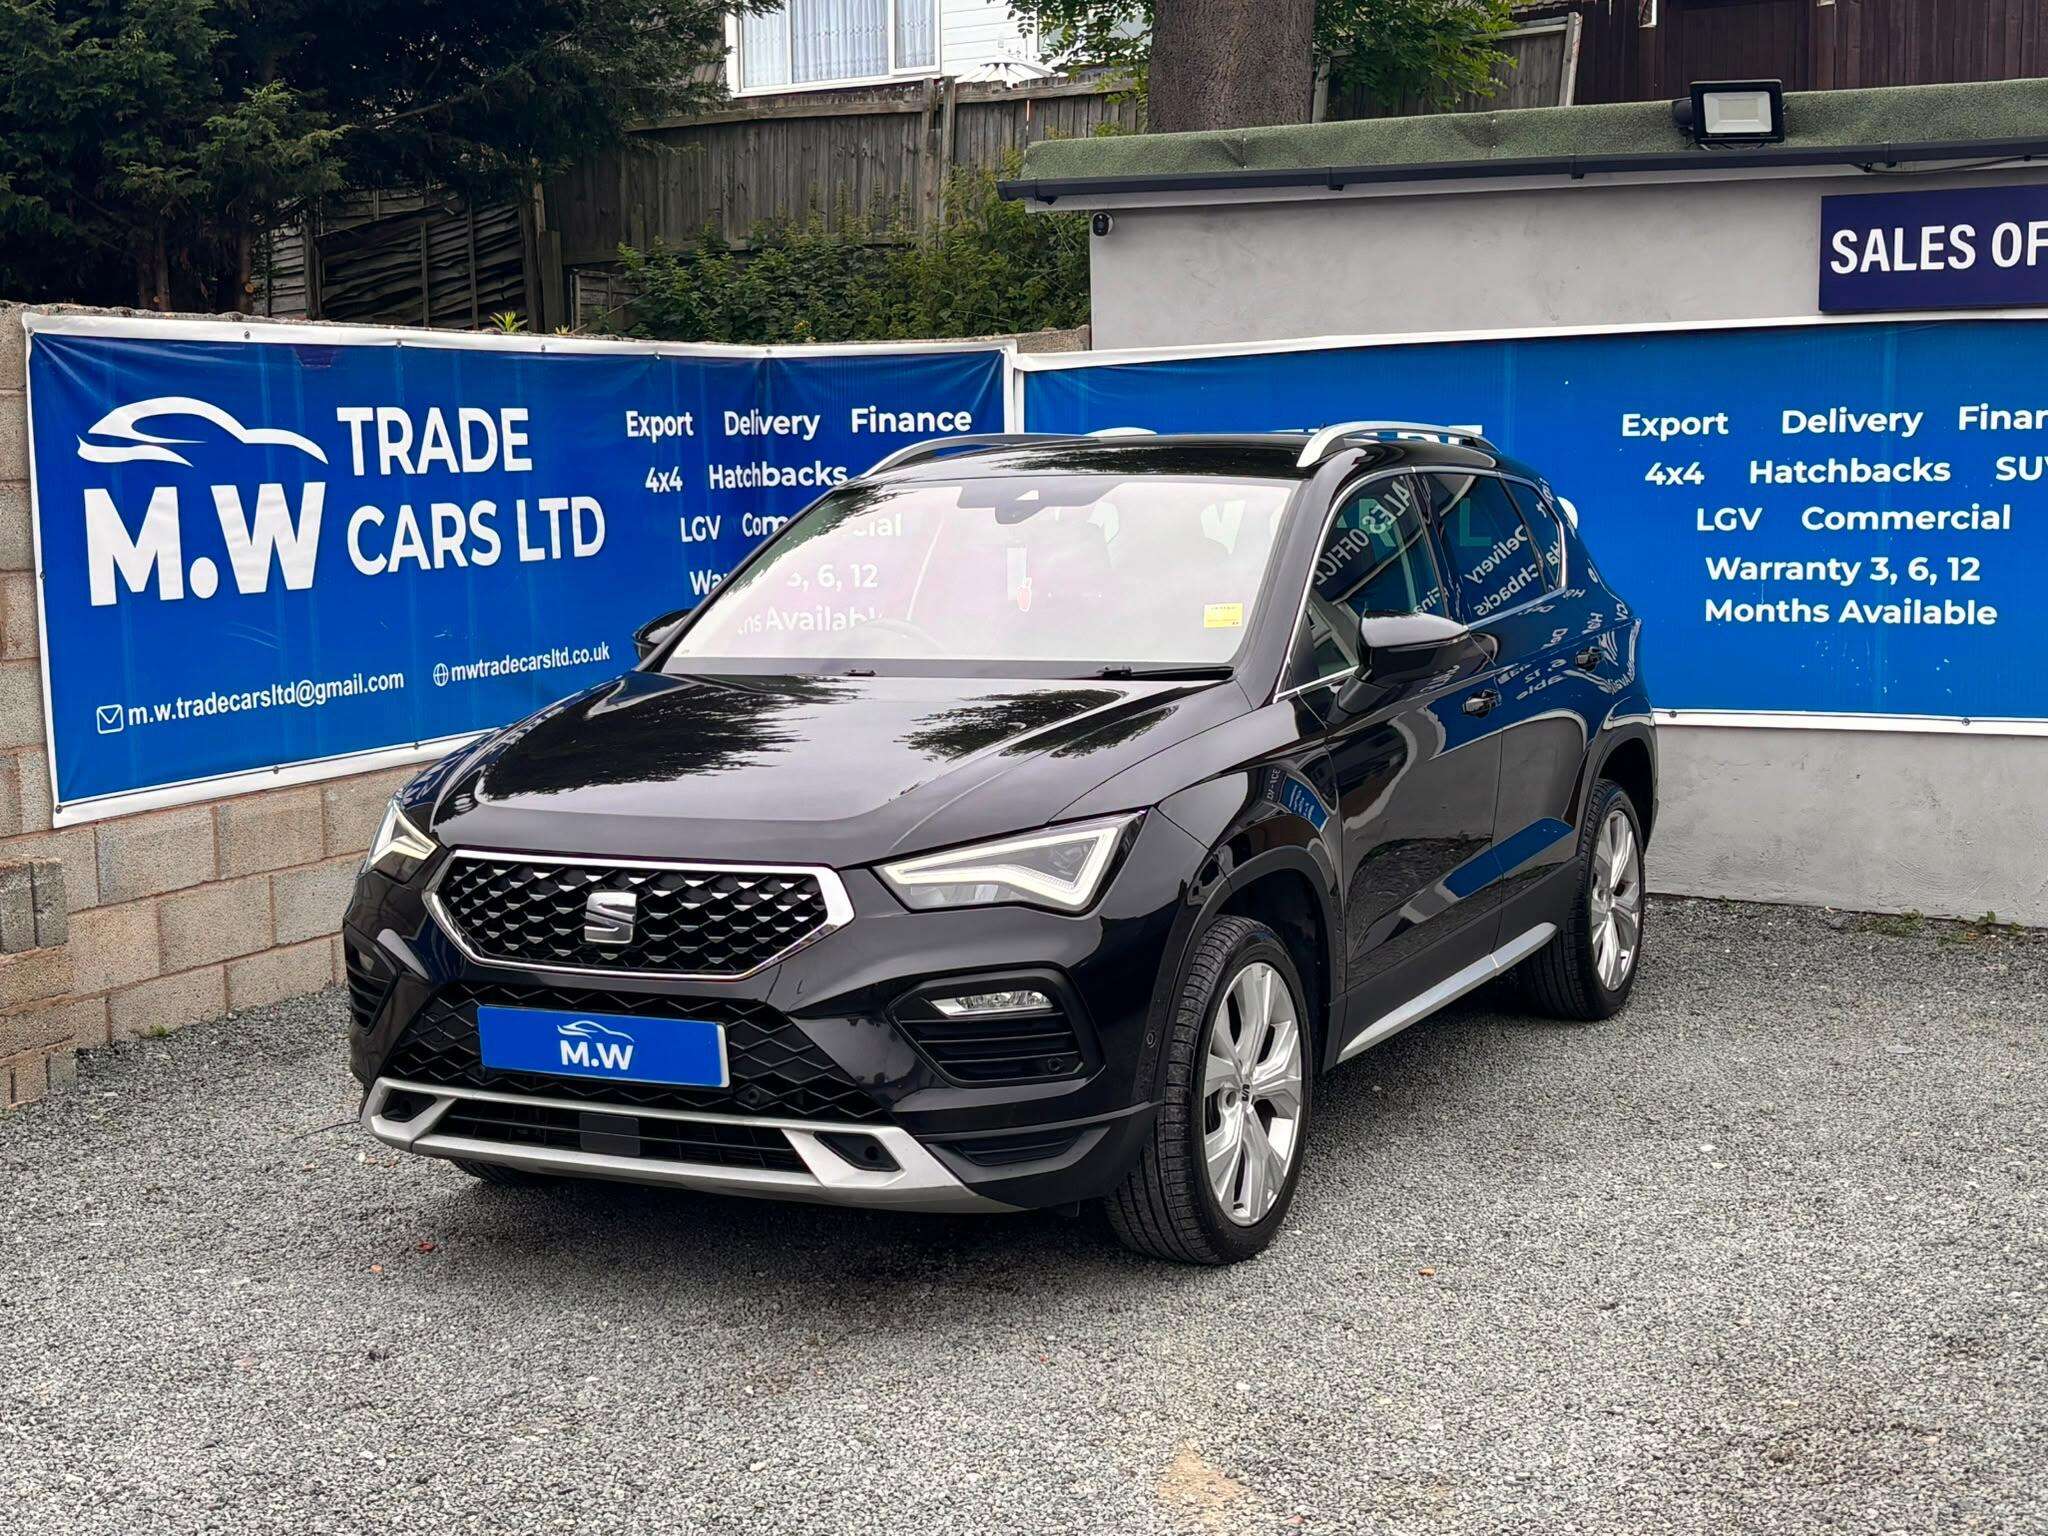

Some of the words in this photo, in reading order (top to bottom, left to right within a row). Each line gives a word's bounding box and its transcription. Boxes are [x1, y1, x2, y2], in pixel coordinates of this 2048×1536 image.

[1830, 224, 1976, 274] SALES
[626, 410, 694, 443] Export
[724, 408, 821, 441] Delivery
[851, 405, 973, 434] Finance
[1622, 412, 1729, 441] Export
[1782, 406, 1924, 437] Delivery
[336, 406, 533, 476] TRADE
[645, 466, 683, 493] 4x4
[708, 460, 849, 490] Hatchbacks
[1645, 462, 1704, 485] 4x4
[1750, 456, 1951, 484] Hatchbacks
[680, 515, 721, 543] LGV
[1697, 507, 1763, 531] LGV
[1801, 503, 2011, 531] Commercial
[83, 481, 327, 607] M.W
[347, 500, 502, 576] CARS
[516, 496, 606, 562] LTD
[853, 563, 879, 589] 12
[1706, 557, 1862, 587] Warranty
[1869, 557, 1898, 586] 3,
[1908, 557, 1938, 586] 6,
[1947, 557, 1981, 581] 12
[1705, 598, 1830, 623] Months
[1838, 598, 1998, 626] Available
[451, 641, 610, 682] mwtradecarsltd.co.uk
[128, 672, 404, 726] m.w.tradecarsltd@gmail.com
[560, 1039, 634, 1070] M.W
